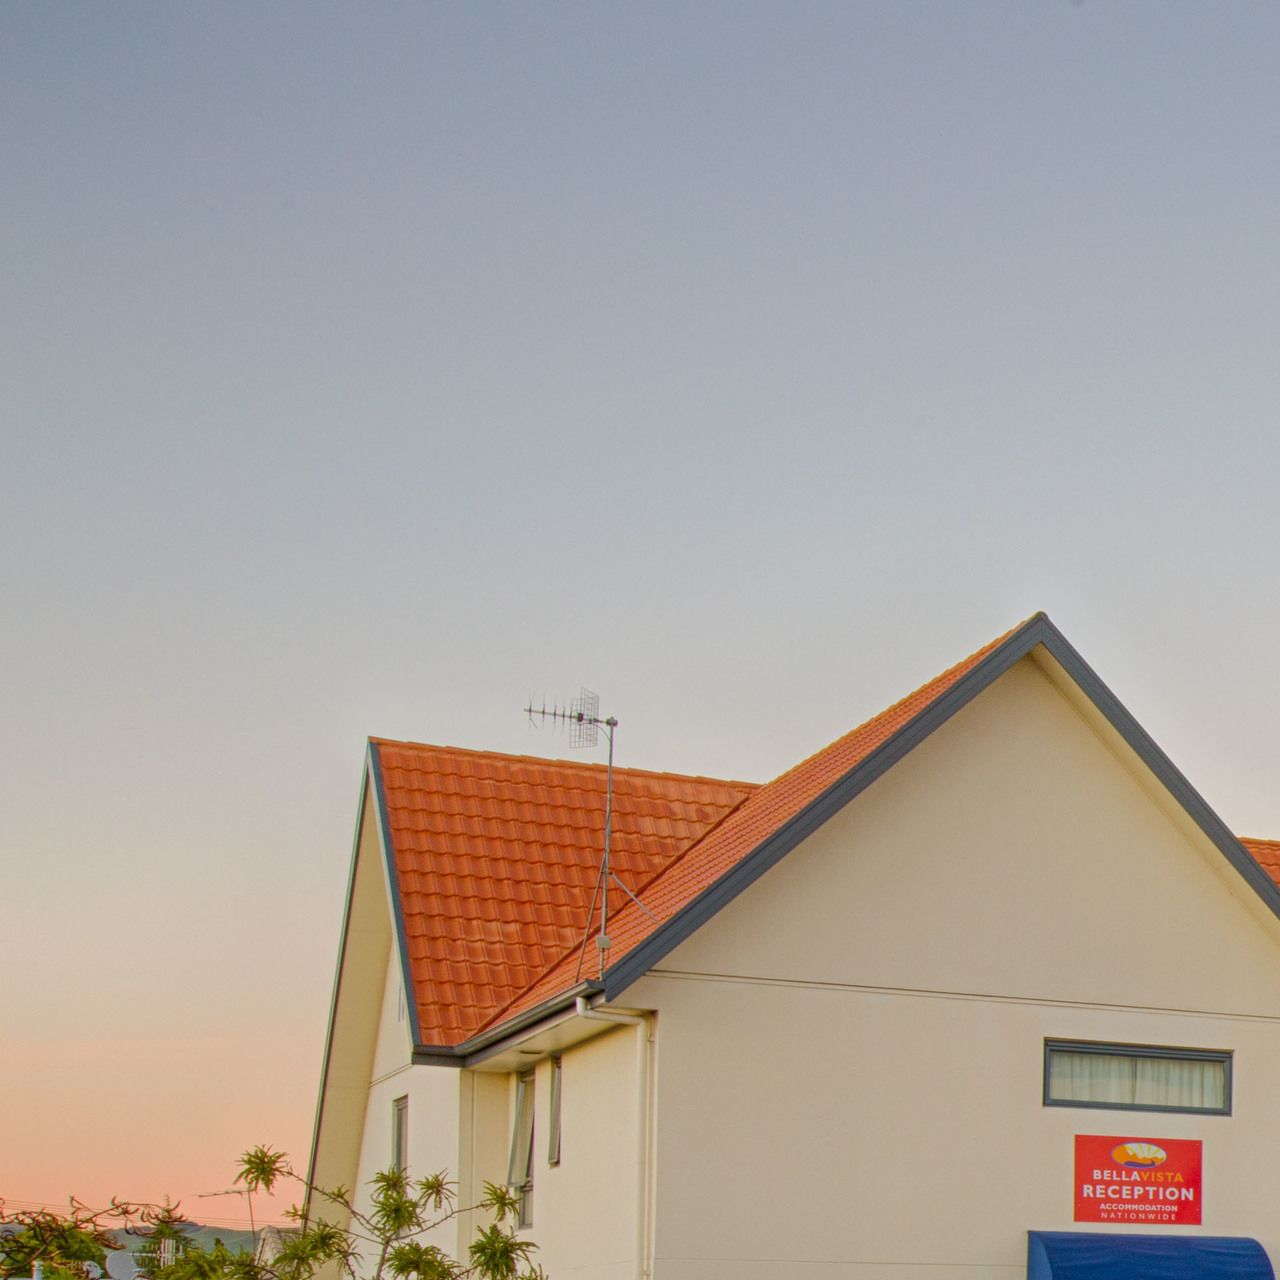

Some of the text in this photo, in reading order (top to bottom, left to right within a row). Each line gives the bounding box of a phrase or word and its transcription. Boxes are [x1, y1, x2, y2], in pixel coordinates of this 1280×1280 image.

[1082, 1184, 1194, 1201] RECEPTION
[1099, 1203, 1178, 1212] ACCOMMODATION
[1100, 1212, 1177, 1221] NATIONWIDE
